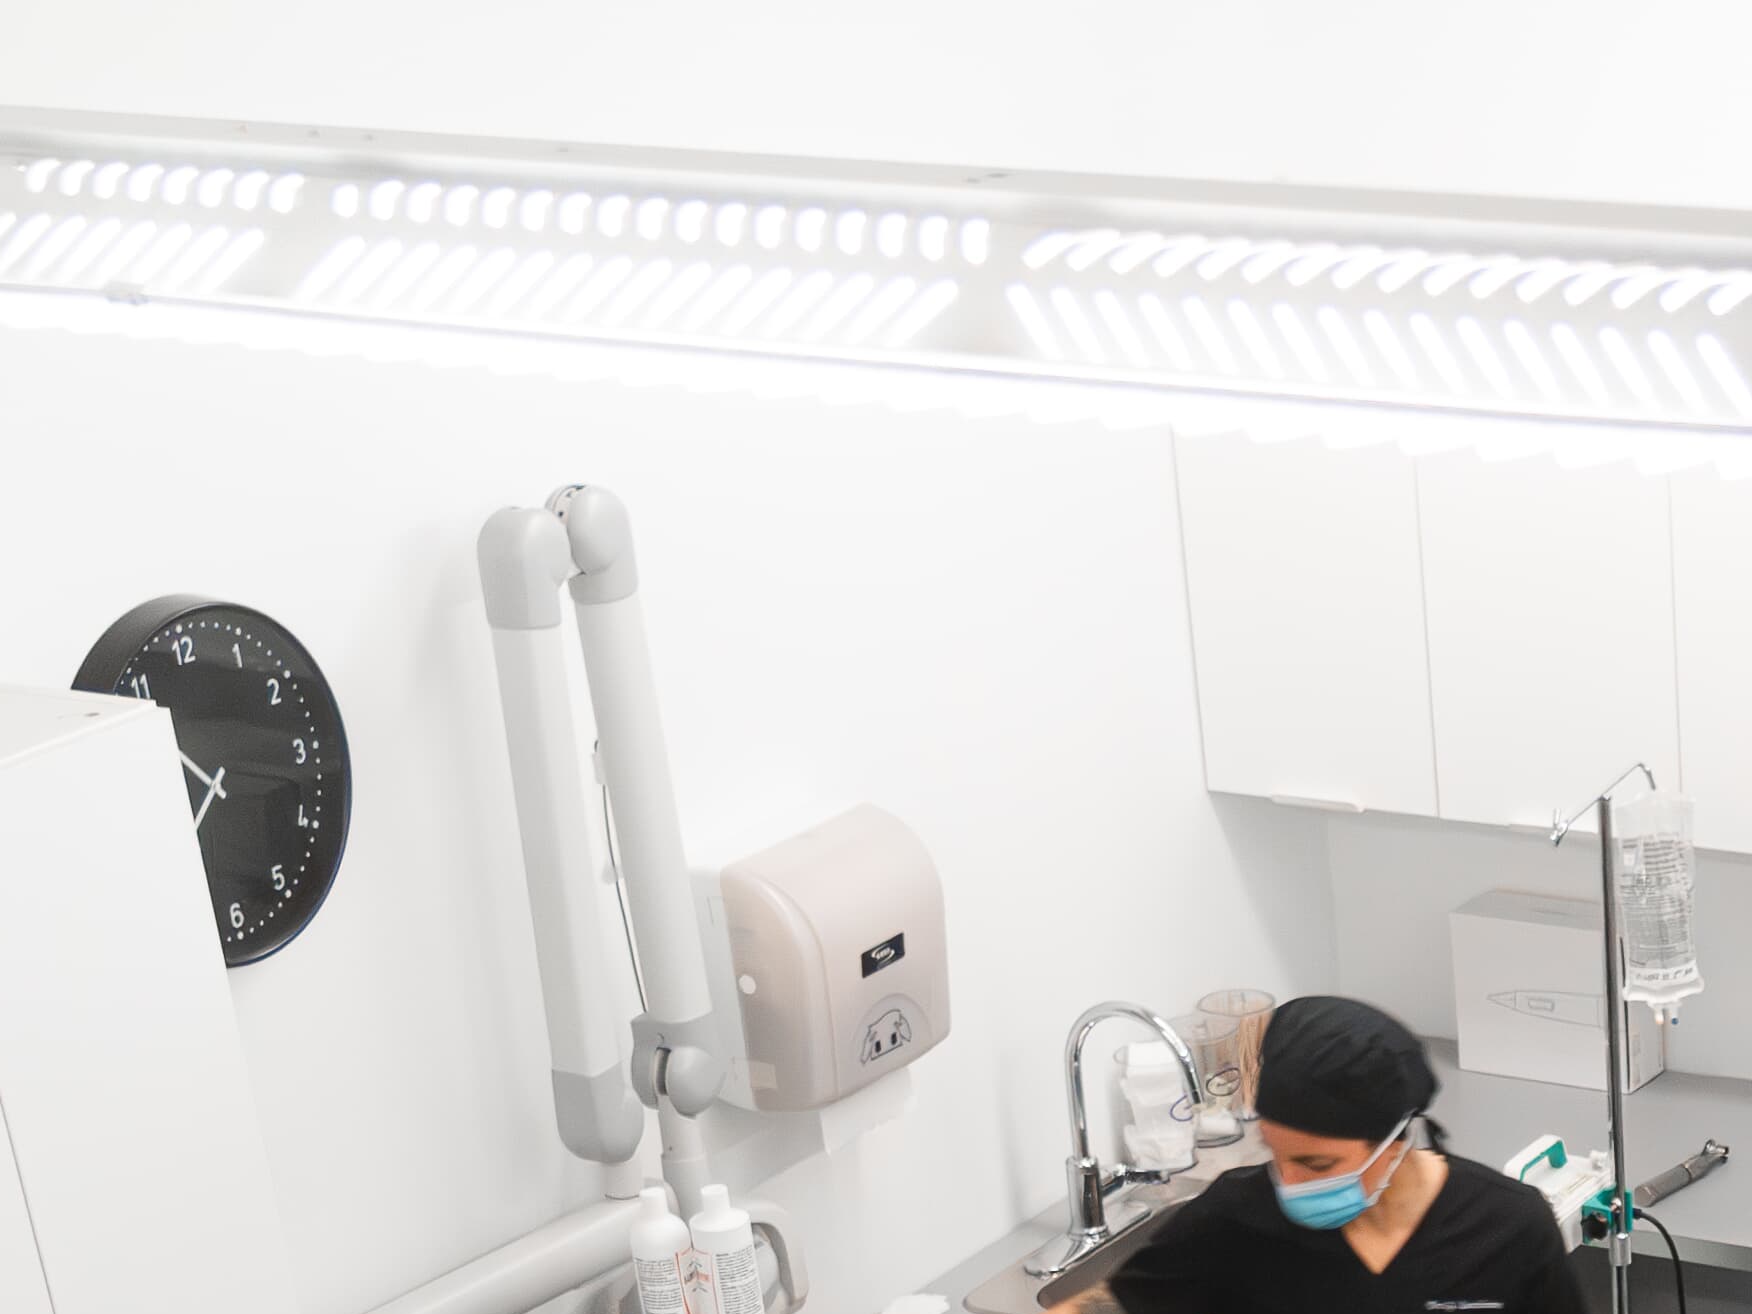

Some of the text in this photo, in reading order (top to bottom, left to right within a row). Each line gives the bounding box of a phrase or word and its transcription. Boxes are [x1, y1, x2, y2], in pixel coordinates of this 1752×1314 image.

[172, 636, 196, 666] 12
[232, 643, 243, 668] 1
[266, 678, 282, 705] 2
[293, 738, 307, 764] 3
[298, 804, 309, 828] 4
[270, 864, 286, 891] 5
[229, 902, 245, 928] 6
